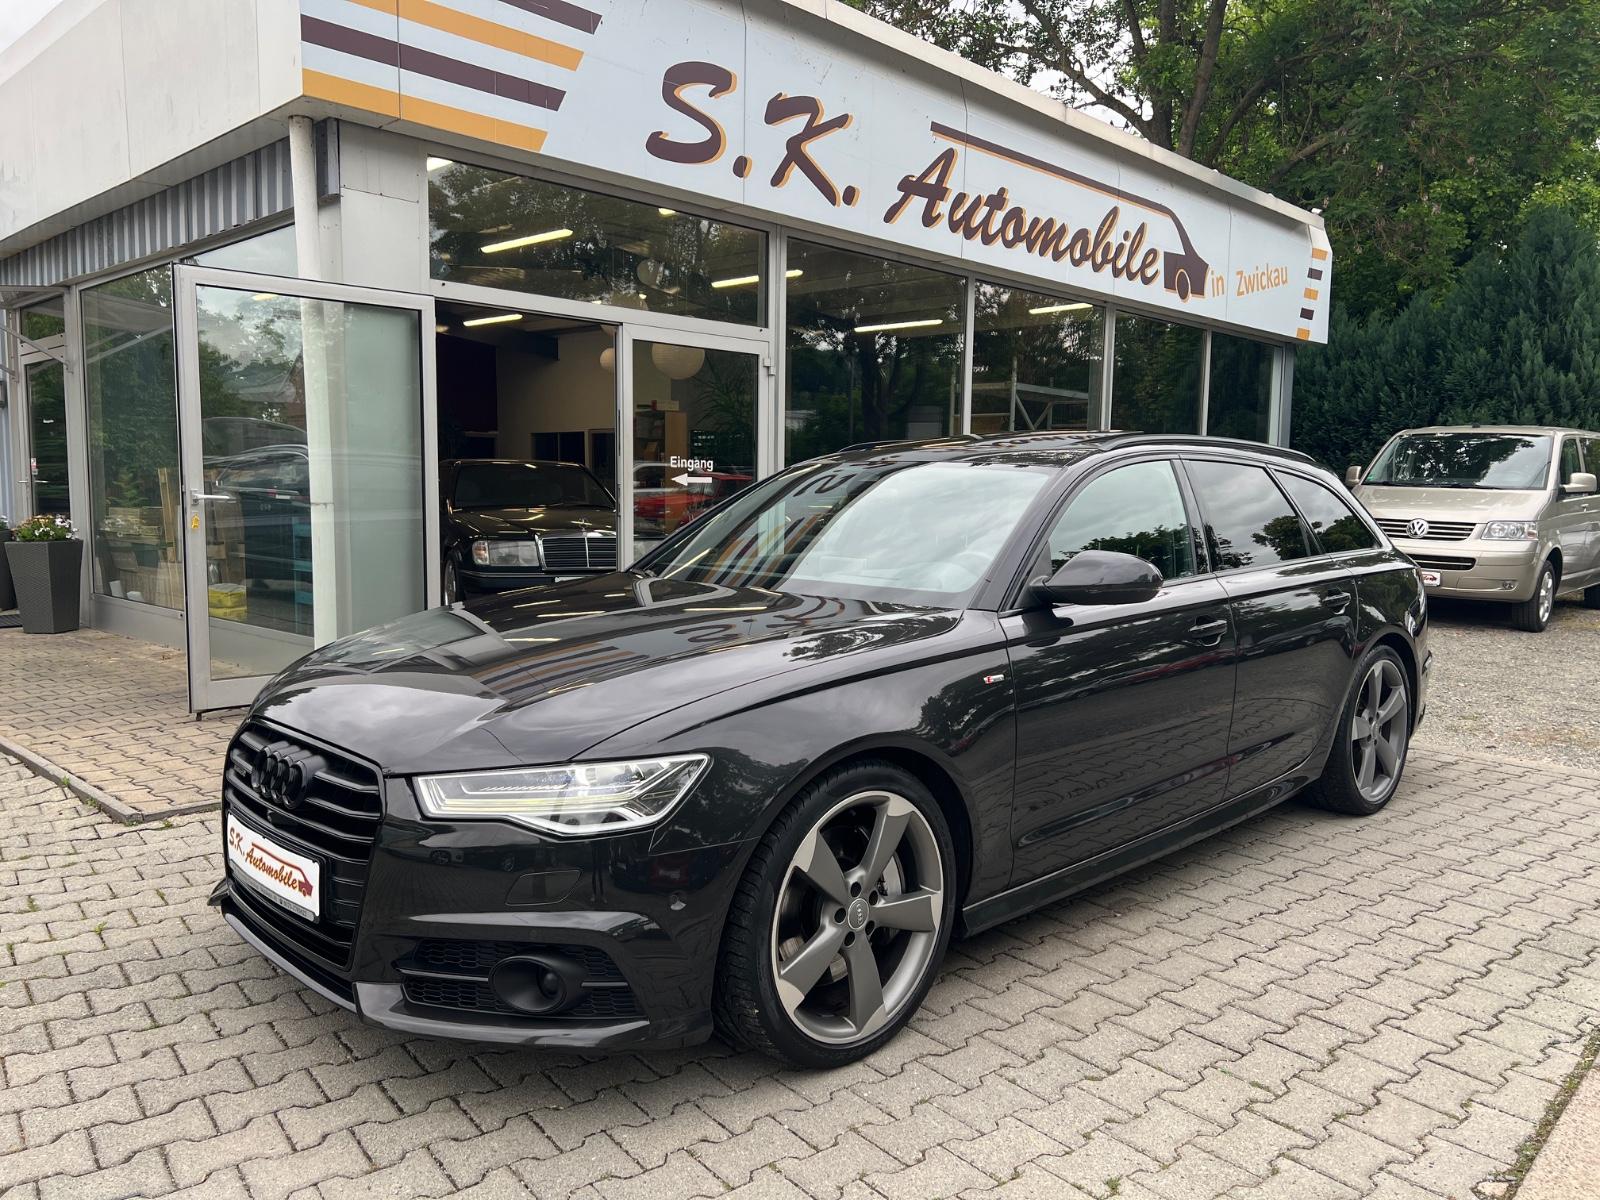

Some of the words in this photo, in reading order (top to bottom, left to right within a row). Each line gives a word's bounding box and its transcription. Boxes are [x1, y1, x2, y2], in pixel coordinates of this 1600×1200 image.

[645, 61, 861, 208] S.K.
[883, 147, 1161, 286] Automobile
[1210, 269, 1225, 298] in
[1235, 262, 1289, 297] Zwickau
[670, 455, 714, 472] Eingang
[246, 848, 298, 889] Automobile
